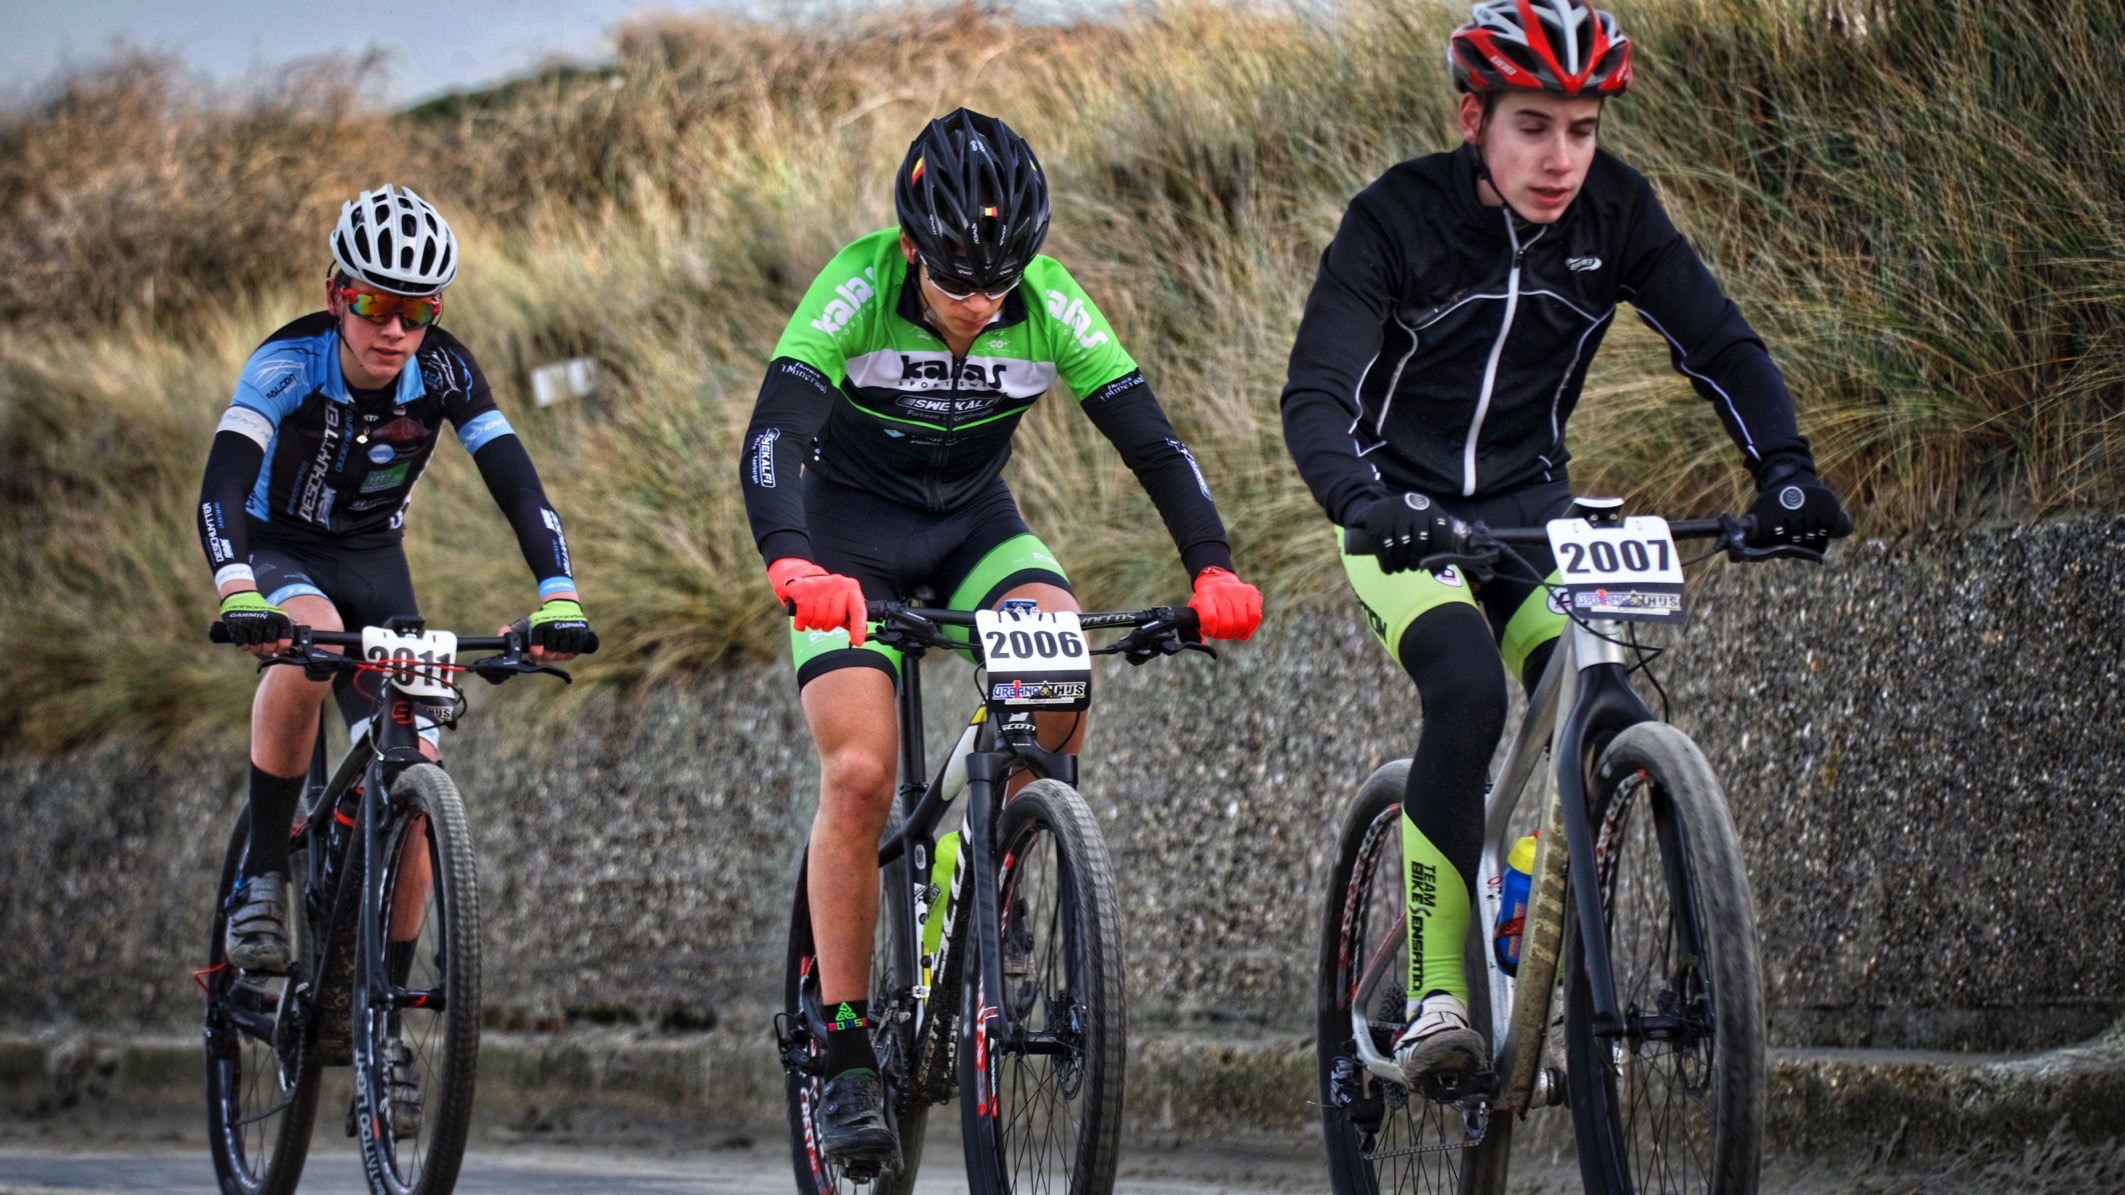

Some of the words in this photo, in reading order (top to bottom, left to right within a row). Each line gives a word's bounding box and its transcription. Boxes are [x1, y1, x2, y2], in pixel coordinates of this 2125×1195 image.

[810, 266, 875, 337] kala
[1045, 288, 1108, 349] alas
[898, 381, 988, 389] SPORTSWE
[900, 355, 1007, 389] kaas
[1559, 539, 1670, 574] 2007
[1079, 612, 1136, 626] yncros
[985, 630, 1084, 660] 2006
[368, 646, 451, 690] 2011
[1411, 860, 1424, 904] BIKE
[1423, 865, 1437, 908] TEAM
[1408, 903, 1433, 991] SENSATIO
[360, 1113, 382, 1180] TATTOO
